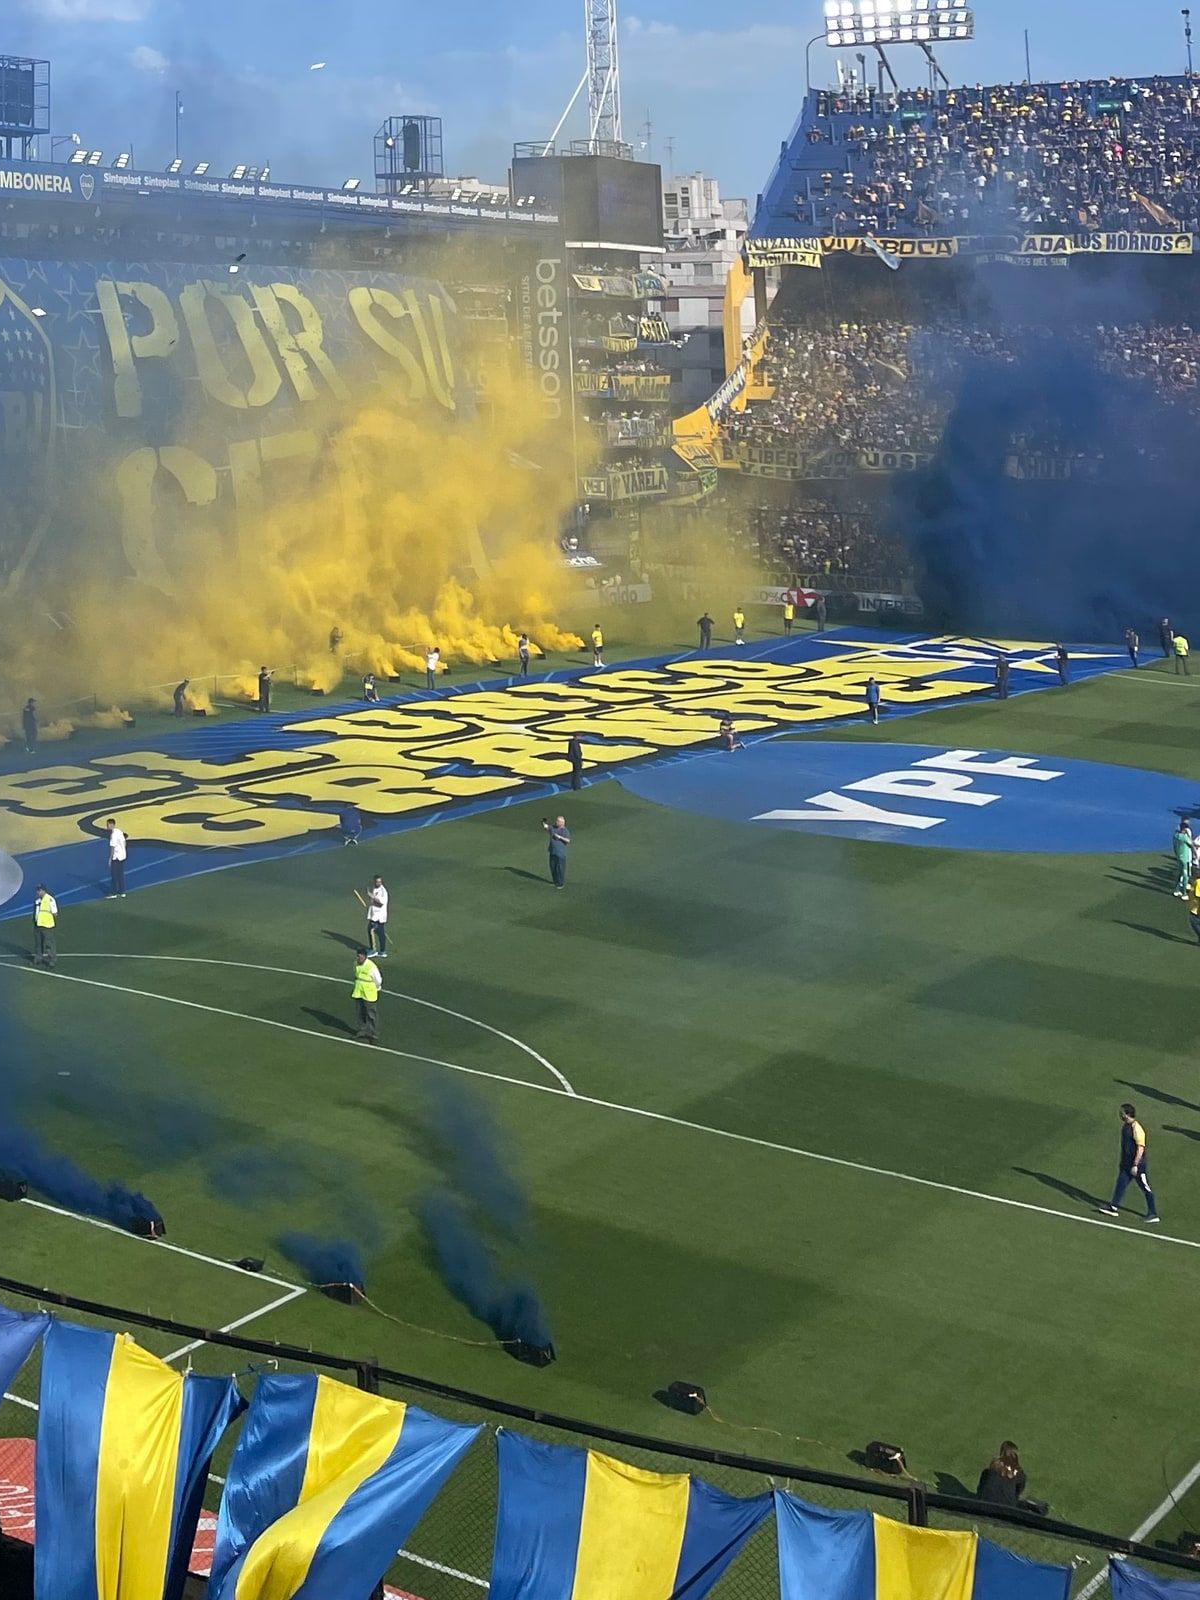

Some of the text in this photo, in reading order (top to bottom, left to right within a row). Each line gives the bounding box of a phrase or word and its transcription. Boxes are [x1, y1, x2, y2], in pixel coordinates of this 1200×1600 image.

[103, 172, 141, 186] Sinteplast
[144, 176, 180, 189] Sinteplast
[184, 180, 219, 193] Sinteplast
[221, 183, 255, 196] Sinteplast
[258, 186, 291, 199] Sinteplast
[293, 189, 324, 202] Sinteplast
[327, 193, 358, 205] Sinteplast
[880, 239, 954, 256] BOCA
[1071, 233, 1174, 252] LOS HORNOS
[749, 253, 821, 268] MAGDALENA
[521, 275, 530, 303] SITIO
[96, 280, 457, 418] POR SU
[535, 258, 563, 420] betsson
[621, 470, 668, 495] VARELA
[90, 672, 999, 848] GRANDE
[749, 749, 1067, 831] YPF
